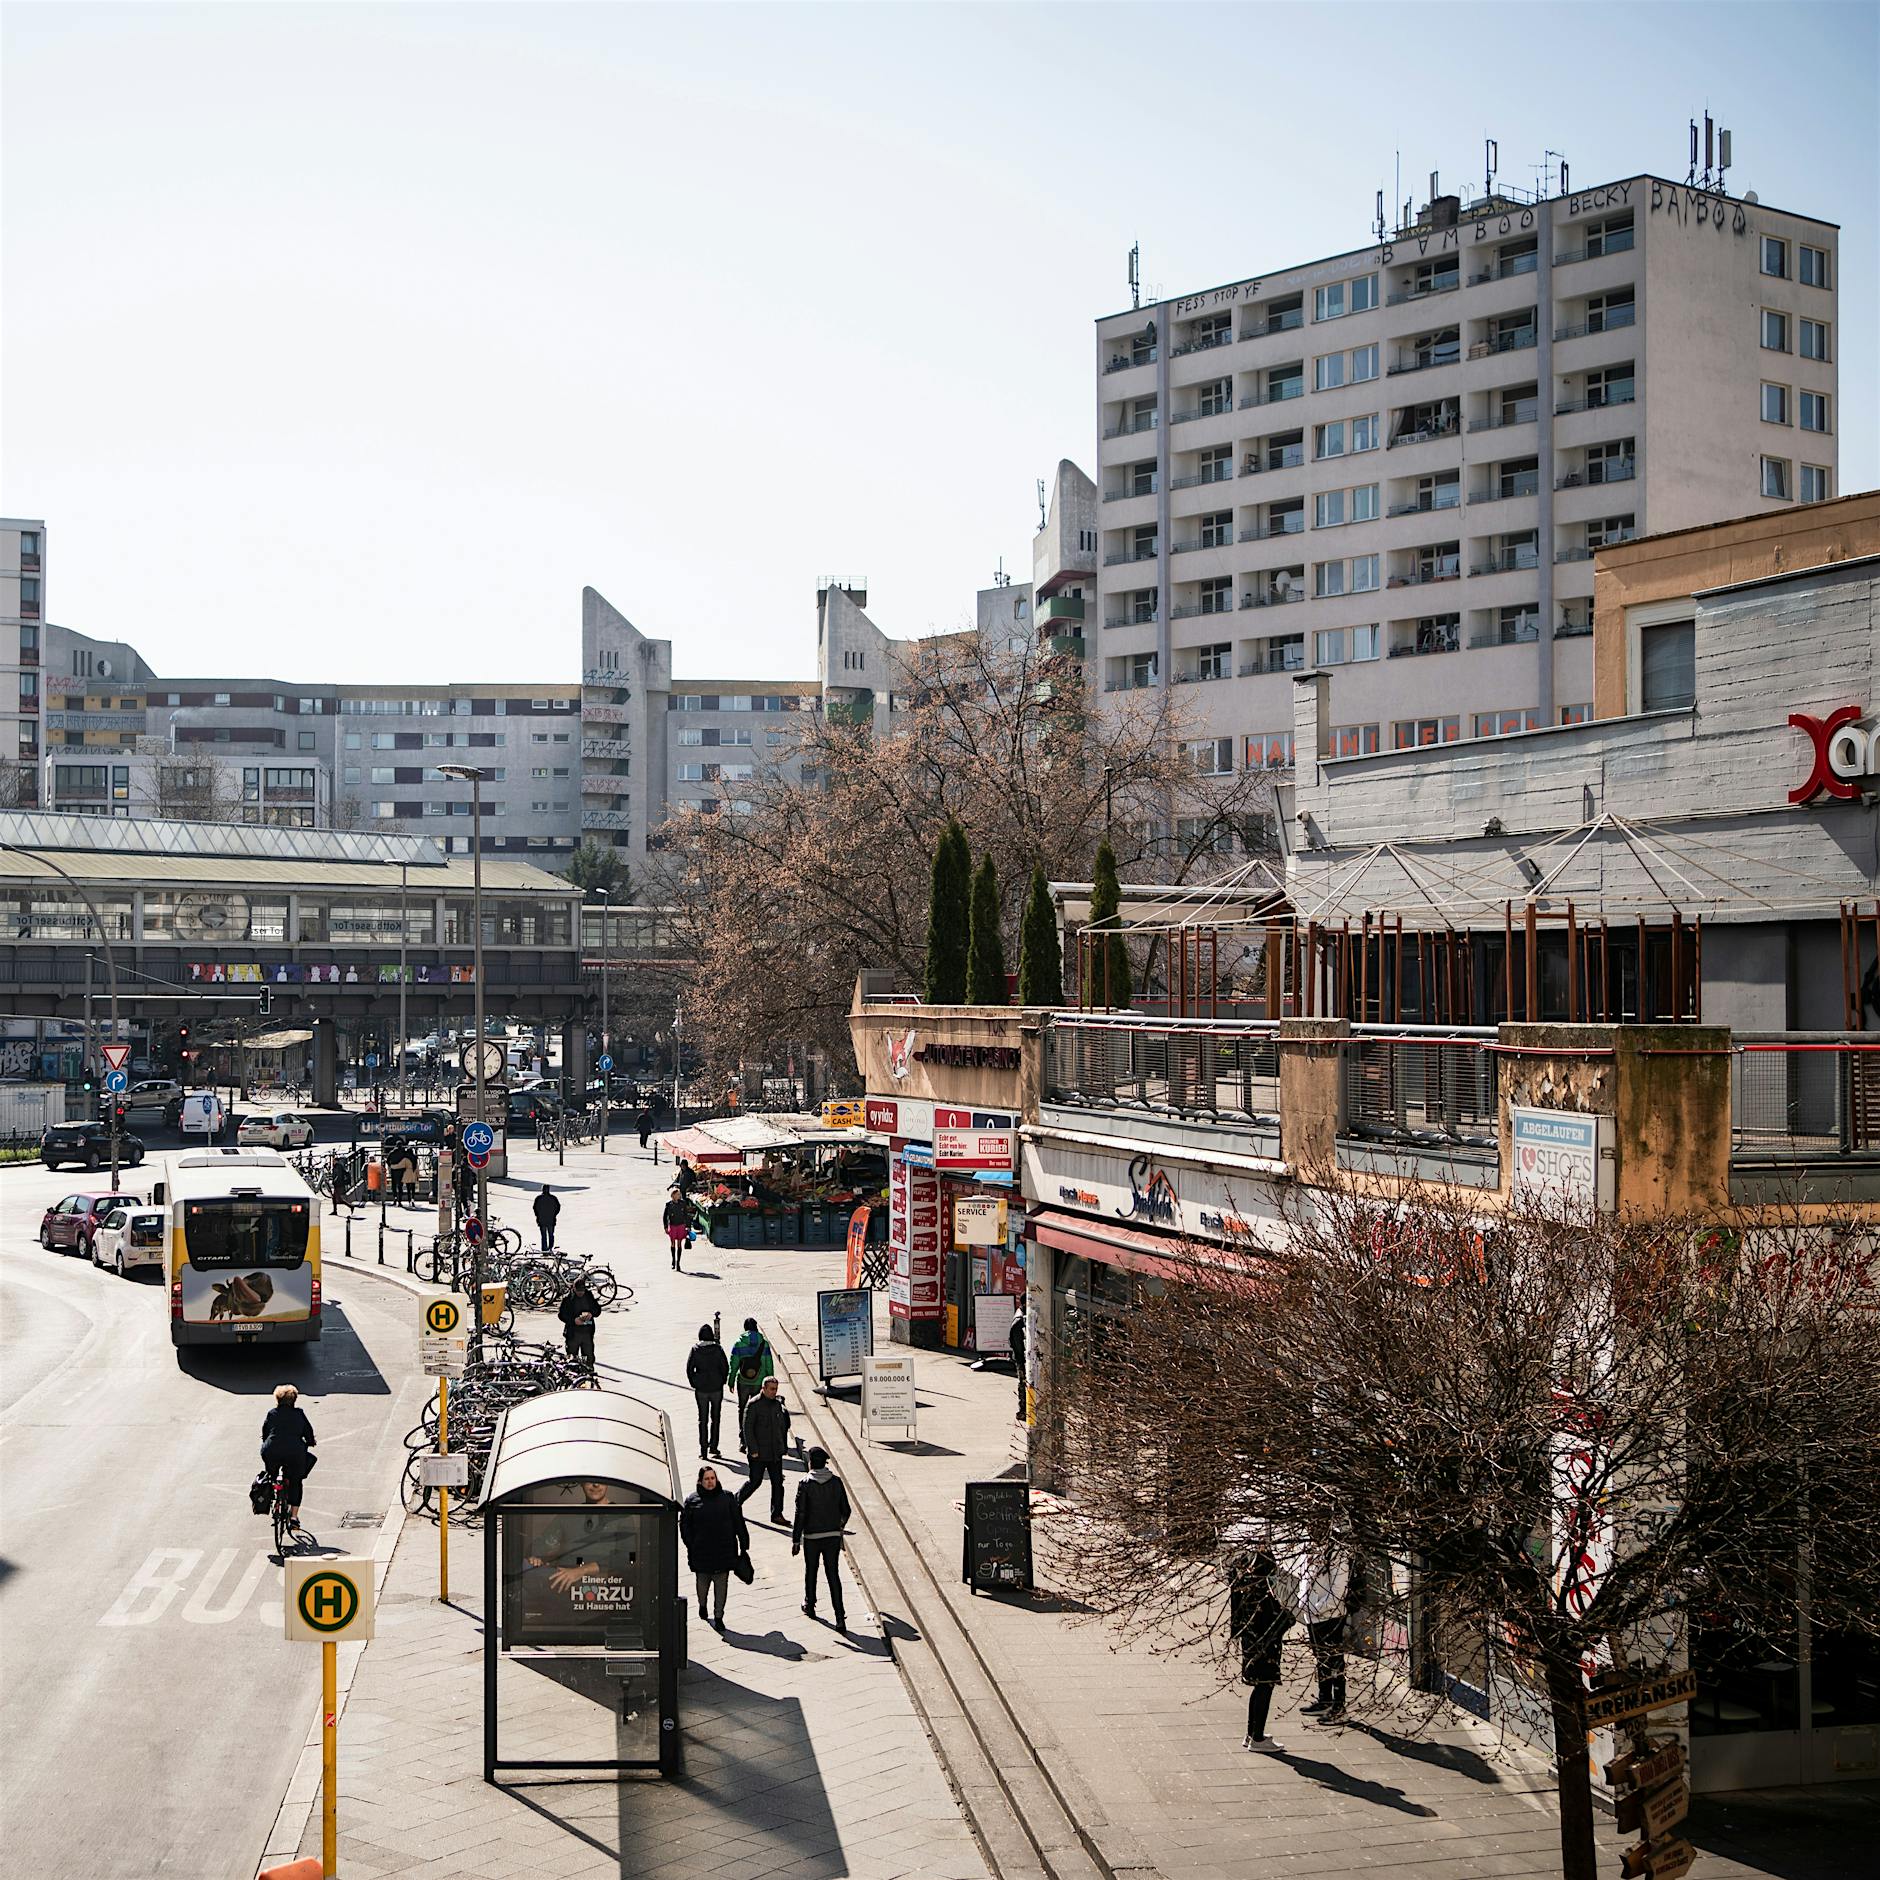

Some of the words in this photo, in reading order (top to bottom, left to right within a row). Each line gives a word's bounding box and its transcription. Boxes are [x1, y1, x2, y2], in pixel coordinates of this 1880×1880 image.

[1570, 182, 1632, 215] BECKY
[1652, 180, 1746, 234] BAMBOO
[1176, 296, 1206, 316] FESS
[1213, 287, 1239, 305] STOP
[922, 1044, 978, 1067] AUTOMATEN
[1522, 1121, 1585, 1141] ABGELAUFEN
[980, 1144, 1008, 1153] KURIER
[1536, 1149, 1592, 1183] SHOES
[957, 1208, 987, 1216] SERVICE
[435, 1307, 450, 1326] H
[582, 1575, 606, 1585] Einer,
[607, 1575, 623, 1584] der
[314, 1585, 342, 1618] H
[573, 1603, 585, 1611] zu
[586, 1602, 614, 1611] Hause
[615, 1602, 631, 1611] hat
